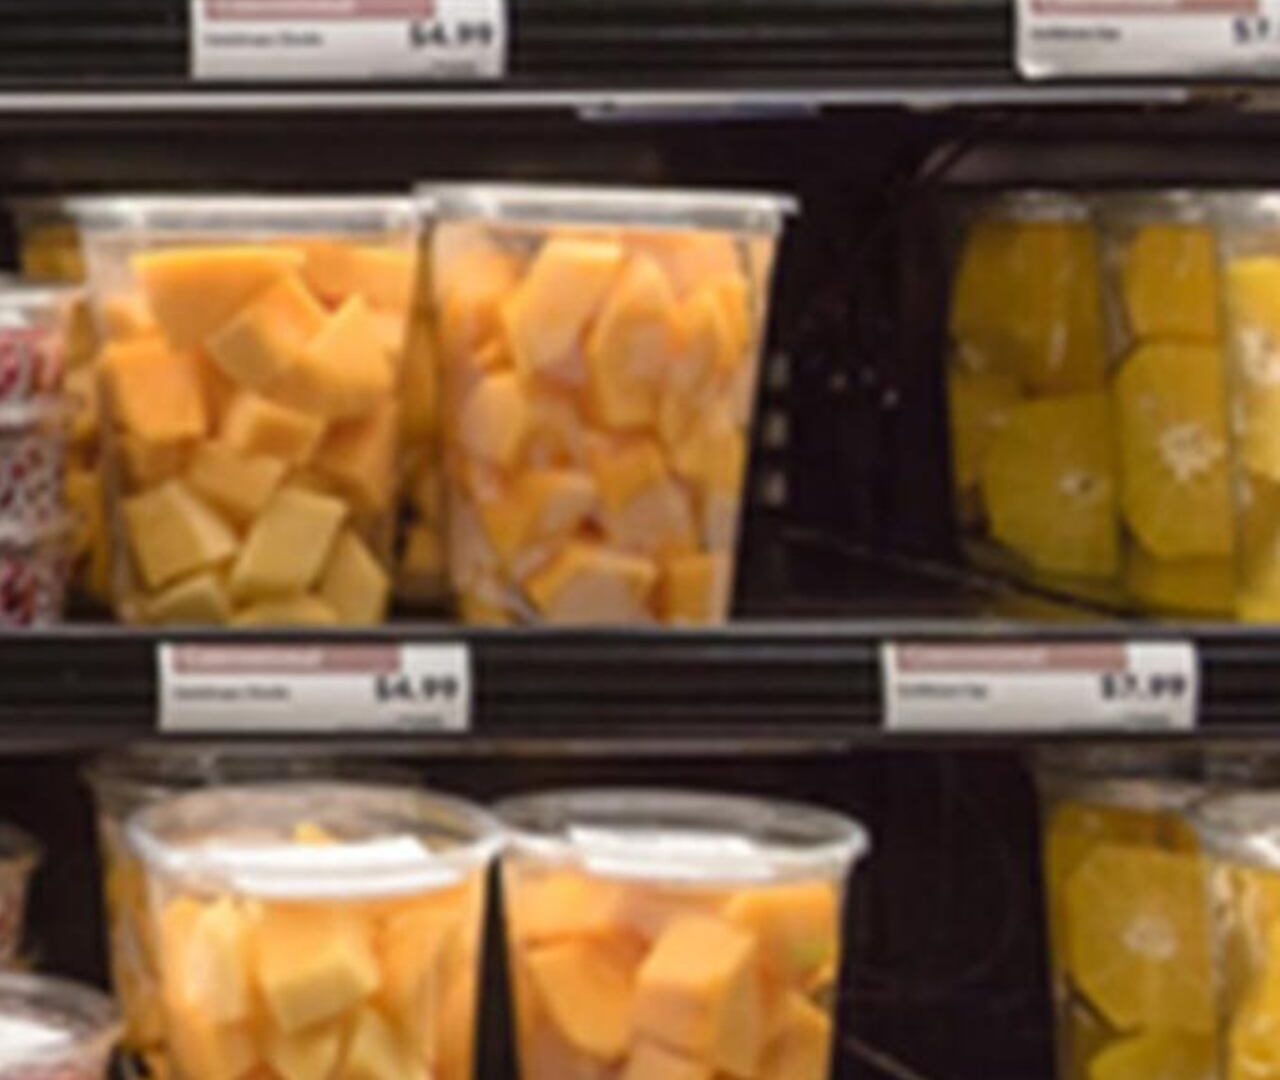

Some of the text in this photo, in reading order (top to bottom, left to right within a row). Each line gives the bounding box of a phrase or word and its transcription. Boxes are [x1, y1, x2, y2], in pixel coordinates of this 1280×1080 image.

[409, 23, 492, 47] $4.99
[374, 676, 457, 700] $4.99
[1102, 675, 1186, 699] $7.99
